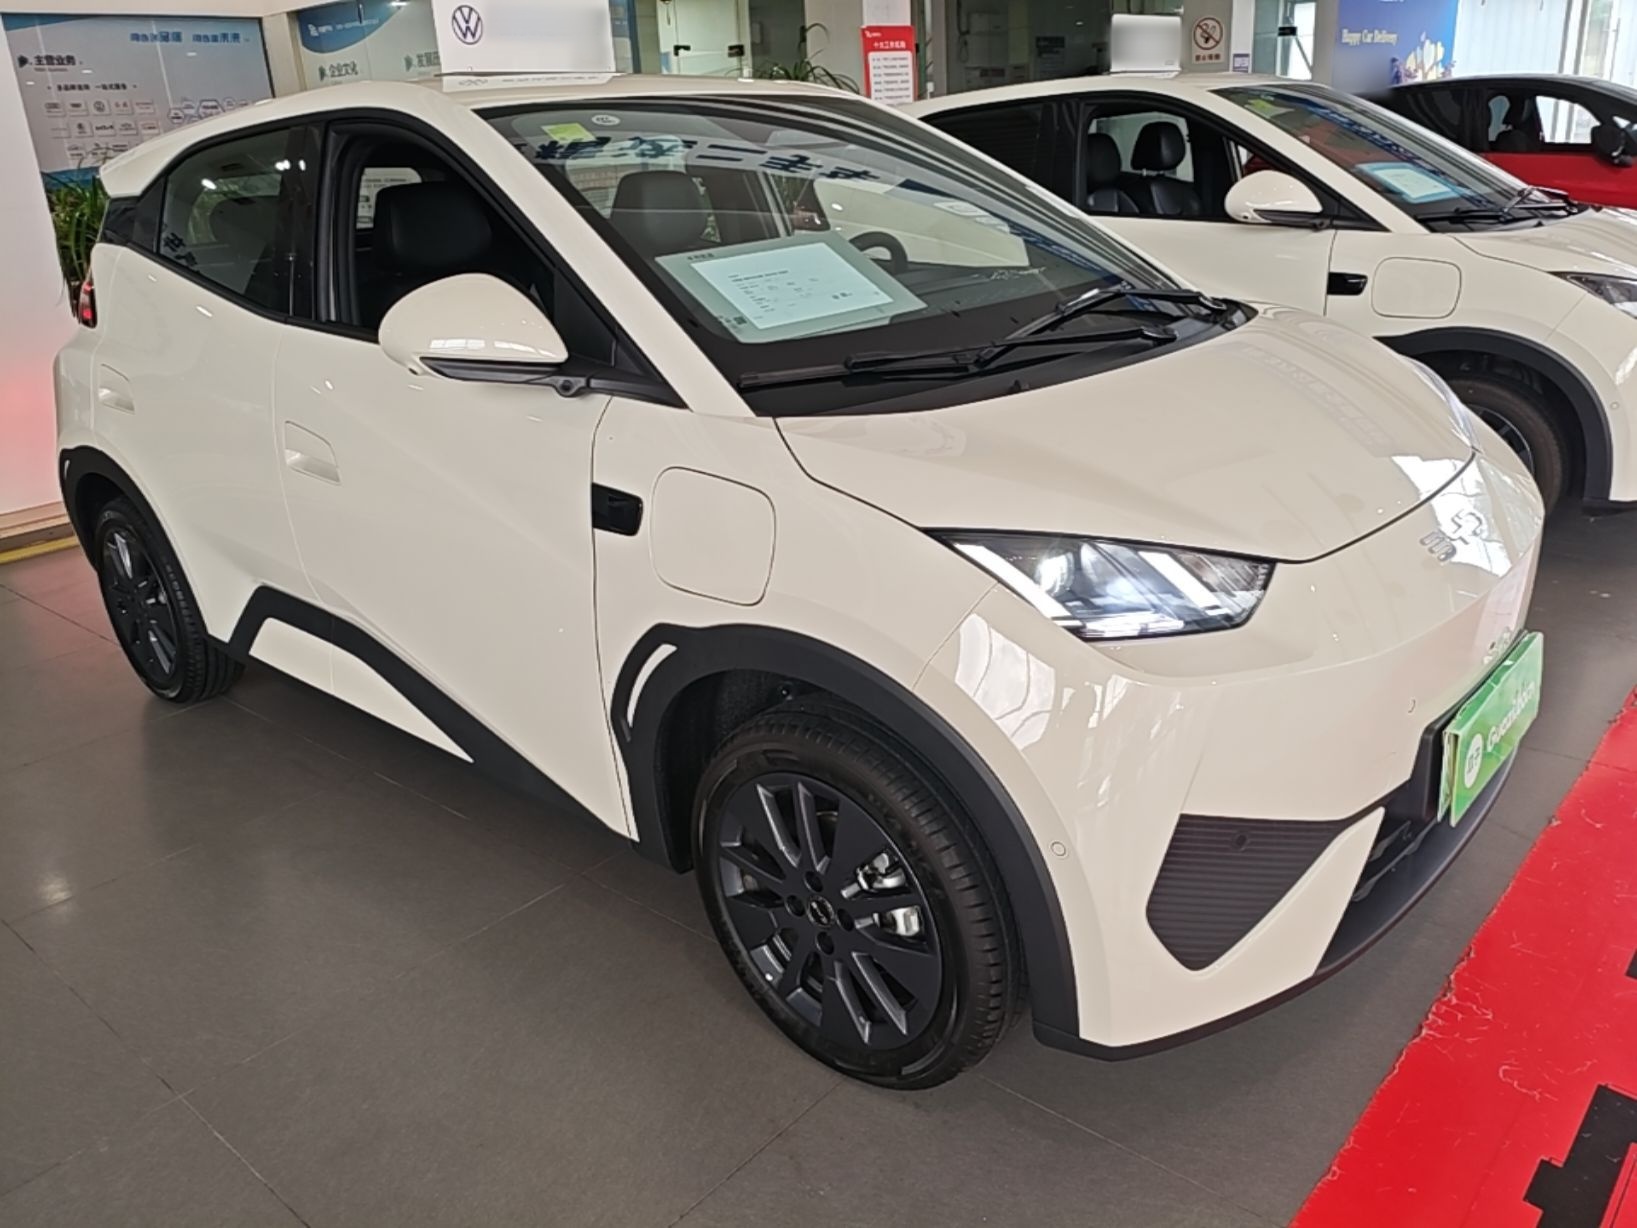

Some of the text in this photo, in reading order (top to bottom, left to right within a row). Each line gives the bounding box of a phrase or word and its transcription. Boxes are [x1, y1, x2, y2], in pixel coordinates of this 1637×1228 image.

[1342, 29, 1398, 47] Happy Car Delivery
[34, 55, 76, 66] 主营业务
[328, 61, 358, 78] 企业文化
